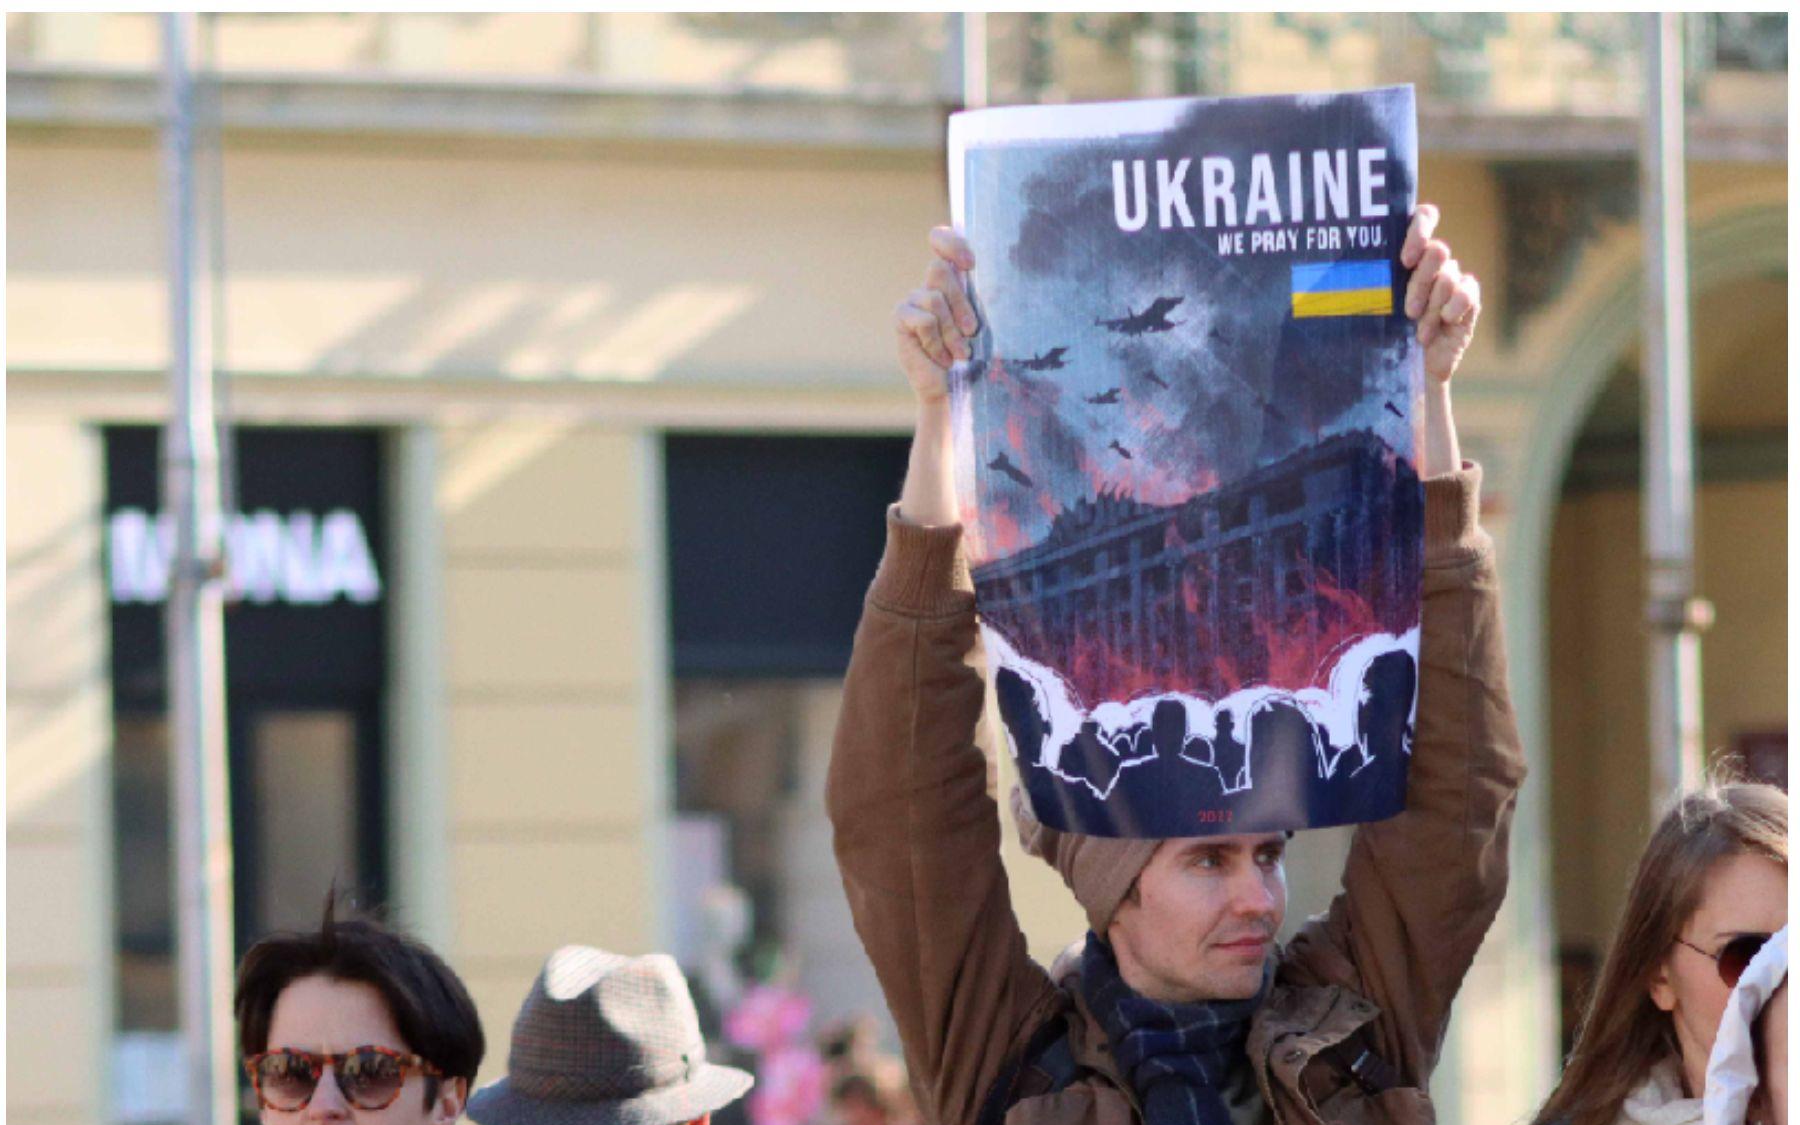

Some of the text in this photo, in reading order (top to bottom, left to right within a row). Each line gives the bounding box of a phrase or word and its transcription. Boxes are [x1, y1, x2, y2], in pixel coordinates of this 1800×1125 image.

[1111, 147, 1390, 232] UKRAINE
[1218, 232, 1244, 255] WE
[1251, 229, 1299, 253] PRAY
[1306, 226, 1341, 250] FOR
[110, 507, 380, 603] MNA
